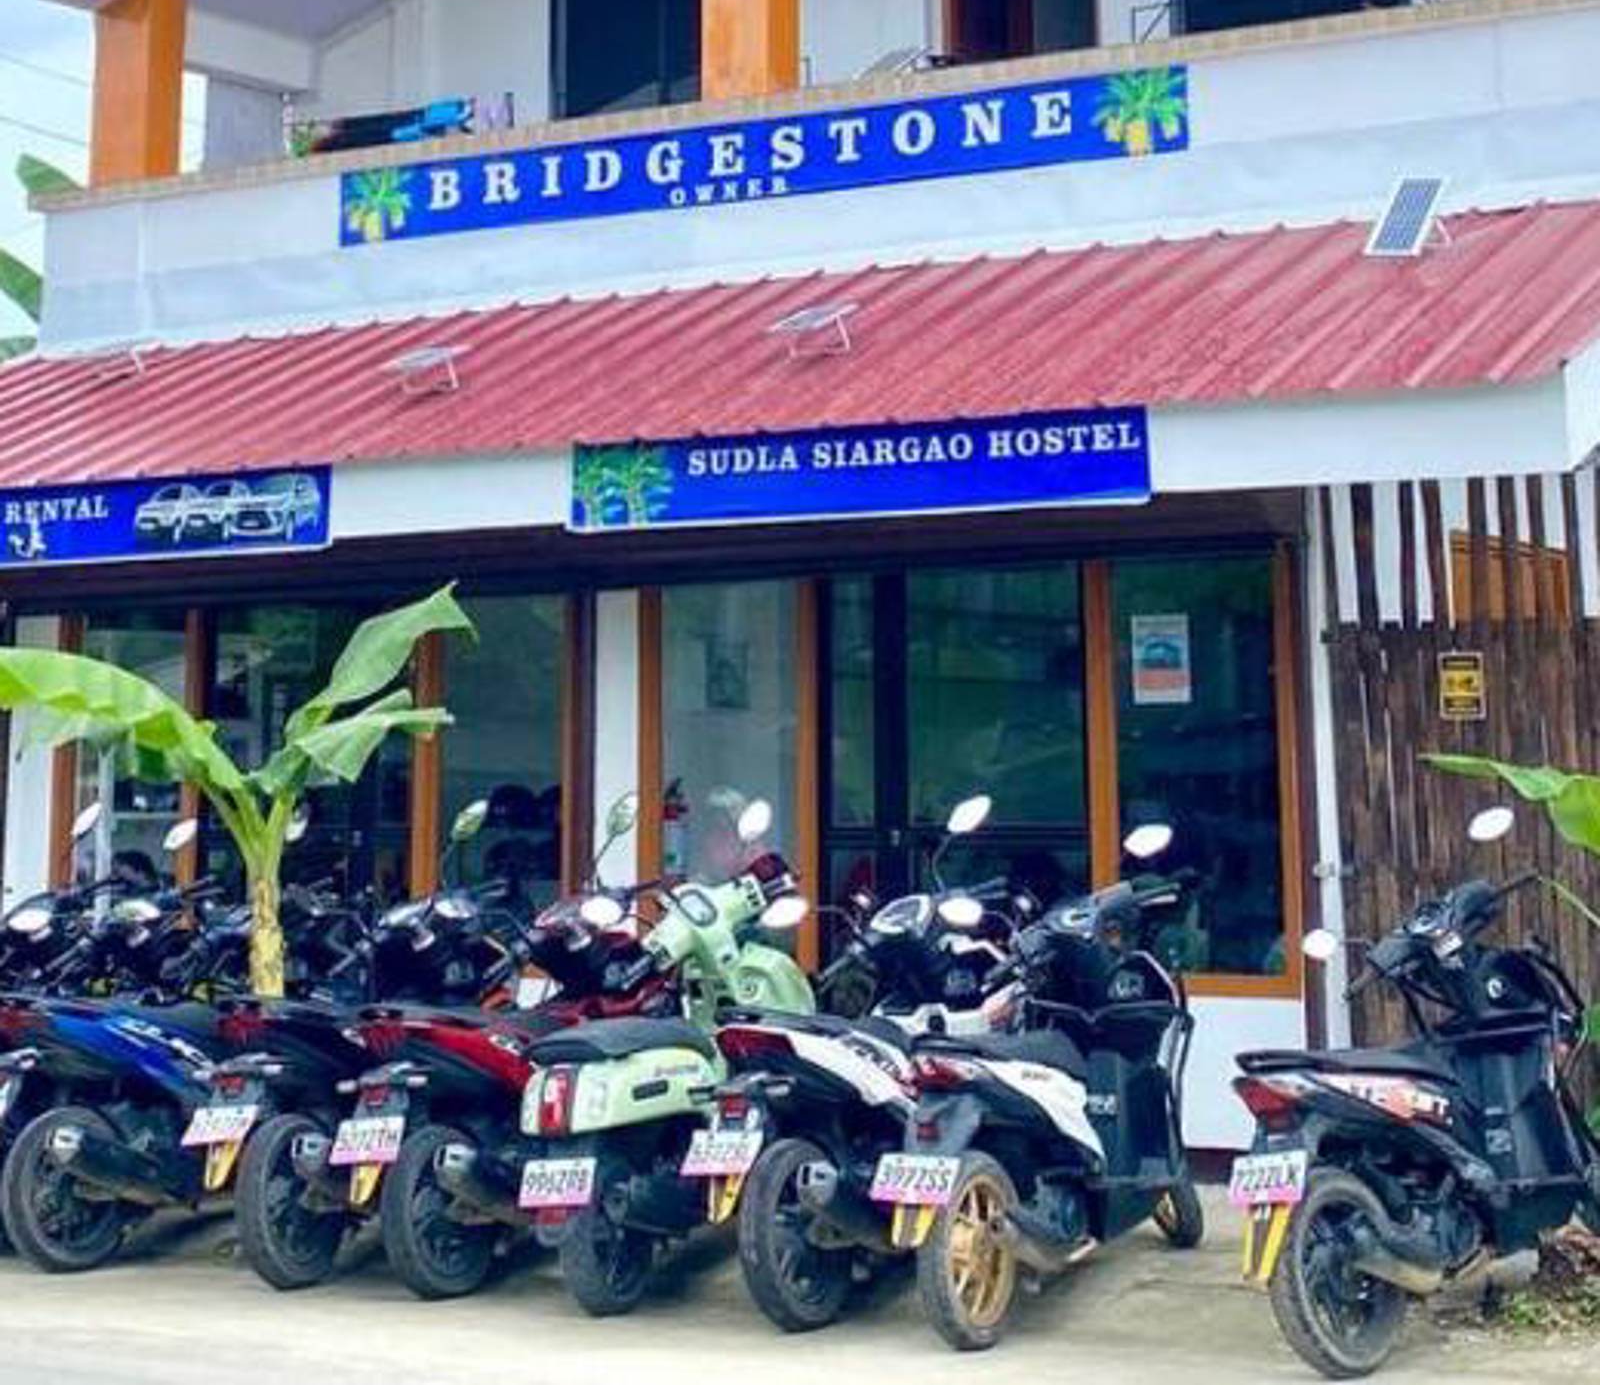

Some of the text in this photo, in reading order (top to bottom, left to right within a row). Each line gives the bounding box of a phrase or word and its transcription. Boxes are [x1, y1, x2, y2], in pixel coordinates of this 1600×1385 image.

[429, 90, 1073, 210] BRIDGESTONE
[669, 175, 790, 208] OWNER
[687, 422, 1141, 475] SUDLA SIARGAO HOSTEL
[4, 495, 109, 524] RENTAL
